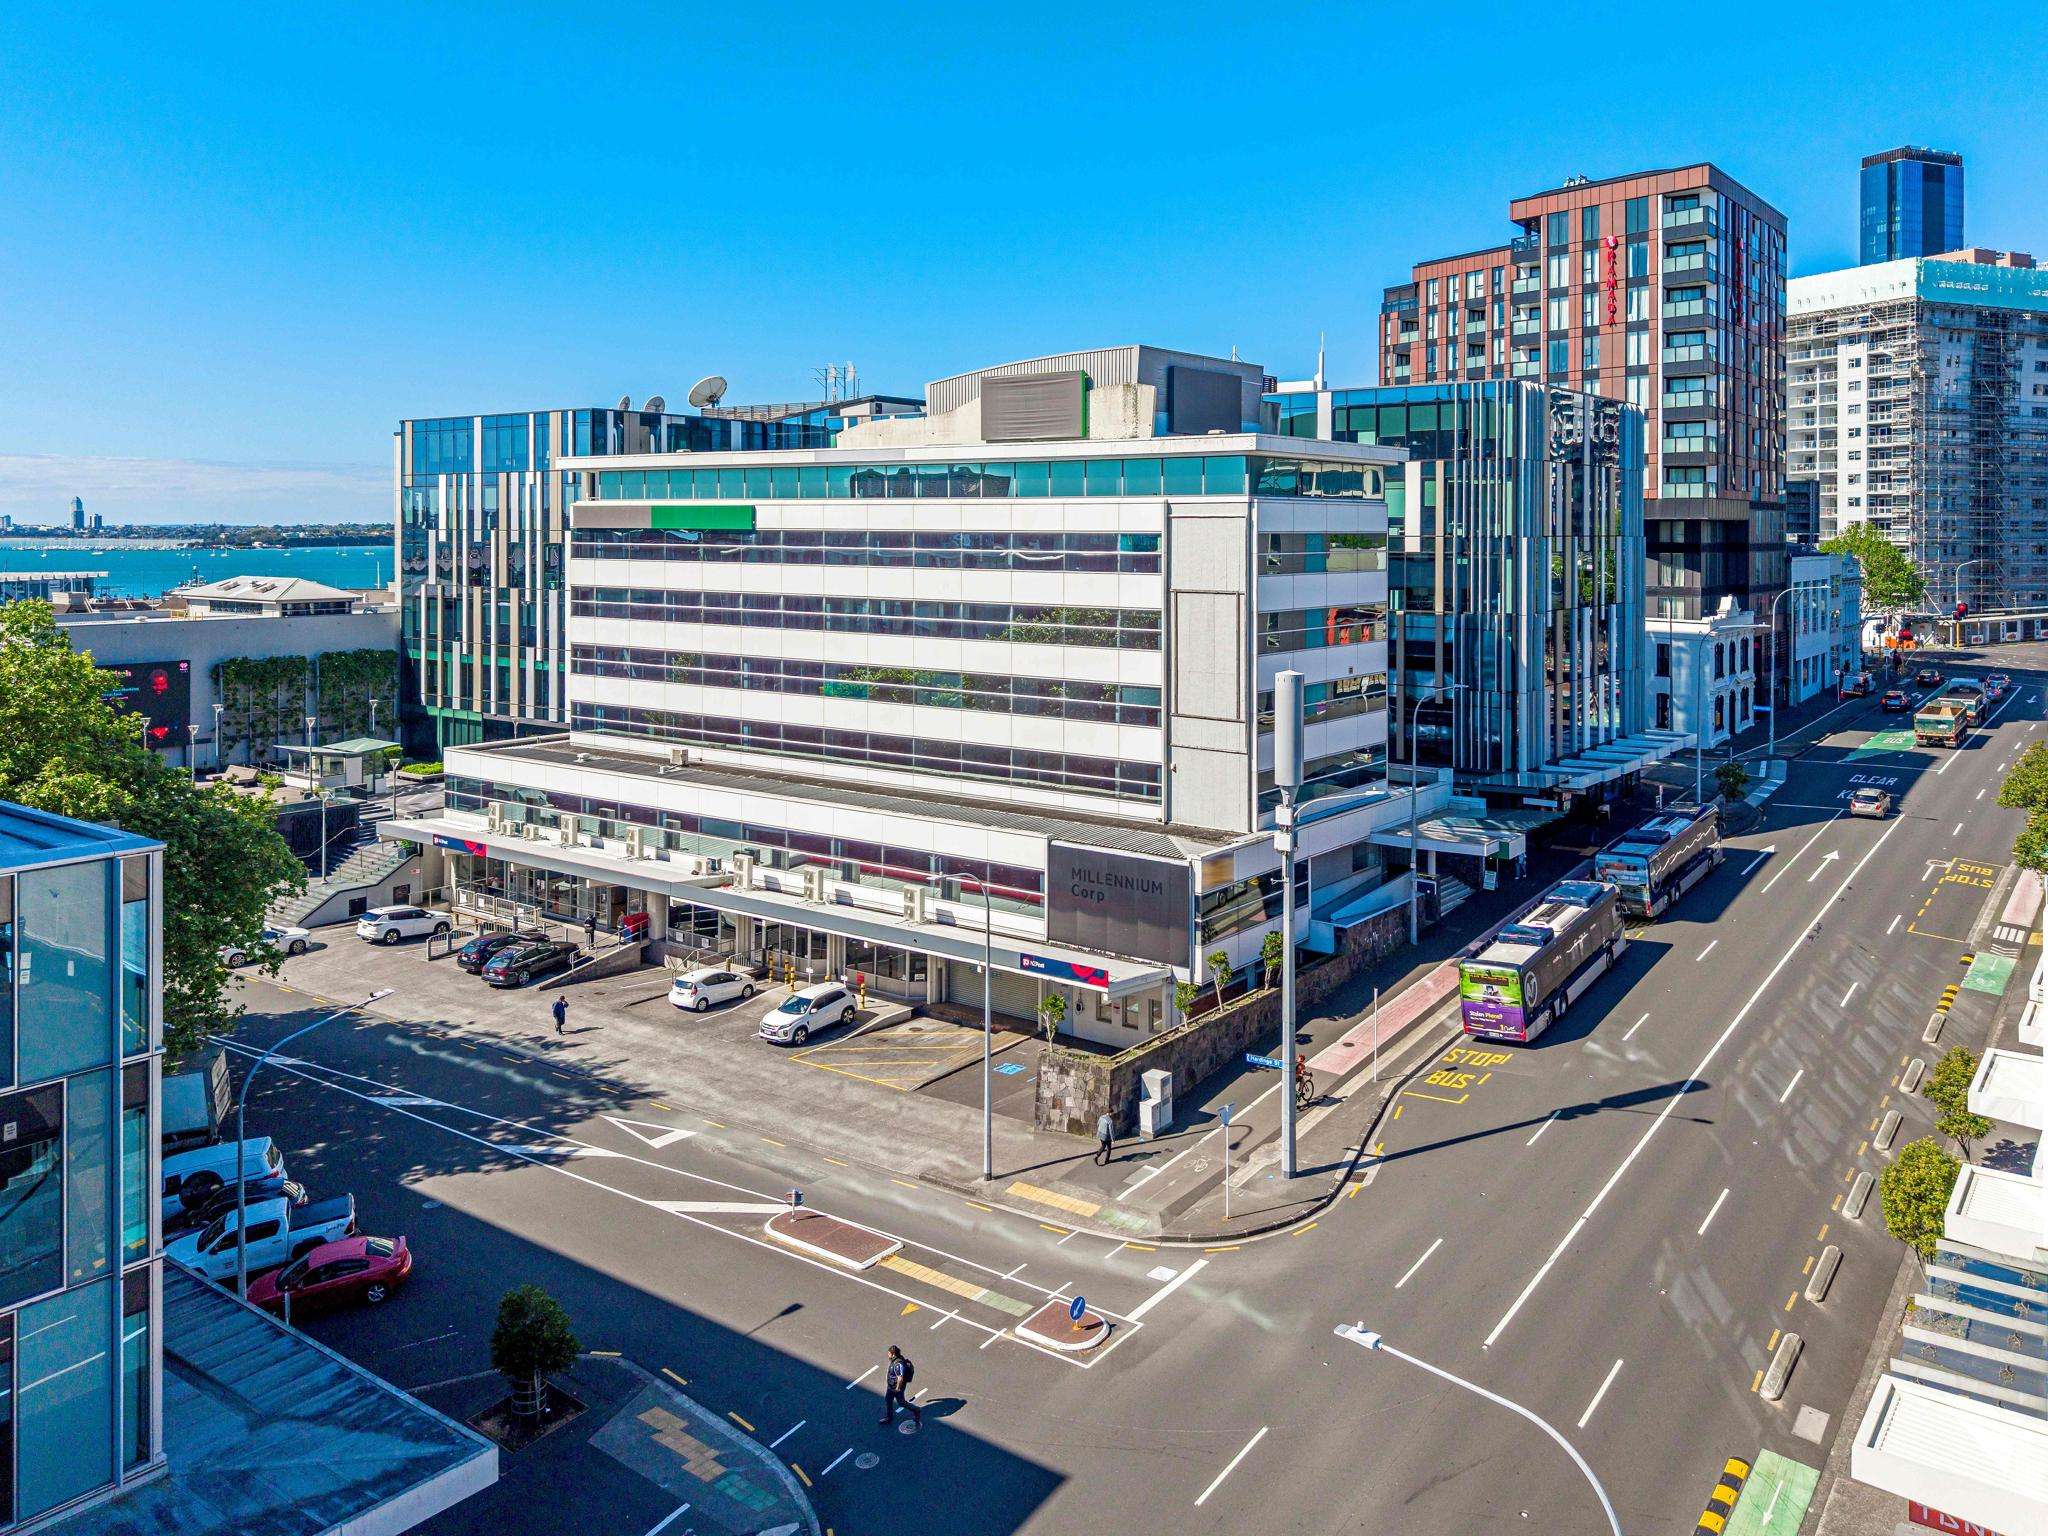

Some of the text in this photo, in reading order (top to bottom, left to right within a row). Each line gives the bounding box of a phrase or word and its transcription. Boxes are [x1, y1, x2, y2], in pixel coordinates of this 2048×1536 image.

[1849, 774, 1898, 786] CLEAR
[1957, 863, 1994, 876] BUS
[1071, 867, 1164, 896] MILLENNIUM
[1945, 874, 1995, 888] STOP
[1071, 883, 1105, 904] Corp
[1442, 1048, 1507, 1067] STOP
[1424, 1070, 1477, 1089] BUS
